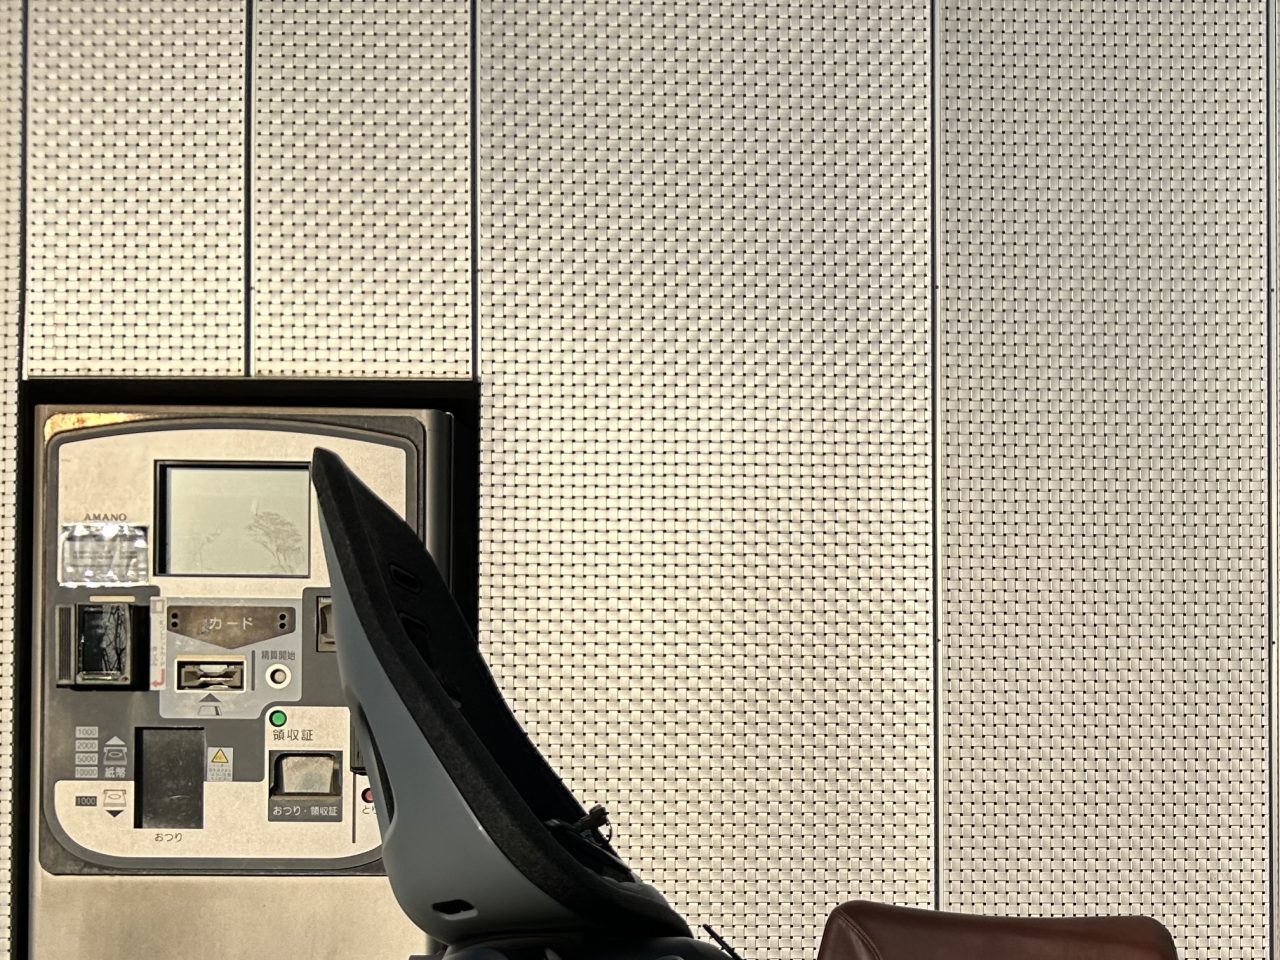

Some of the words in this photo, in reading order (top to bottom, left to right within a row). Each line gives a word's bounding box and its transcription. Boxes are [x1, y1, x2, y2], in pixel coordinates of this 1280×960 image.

[83, 513, 127, 521] AMANO
[208, 616, 254, 630] カード
[78, 728, 97, 736] 1000
[272, 729, 314, 741] 領収証
[77, 741, 97, 750] 2000
[77, 797, 97, 805] 1000
[154, 832, 183, 842] おつり
